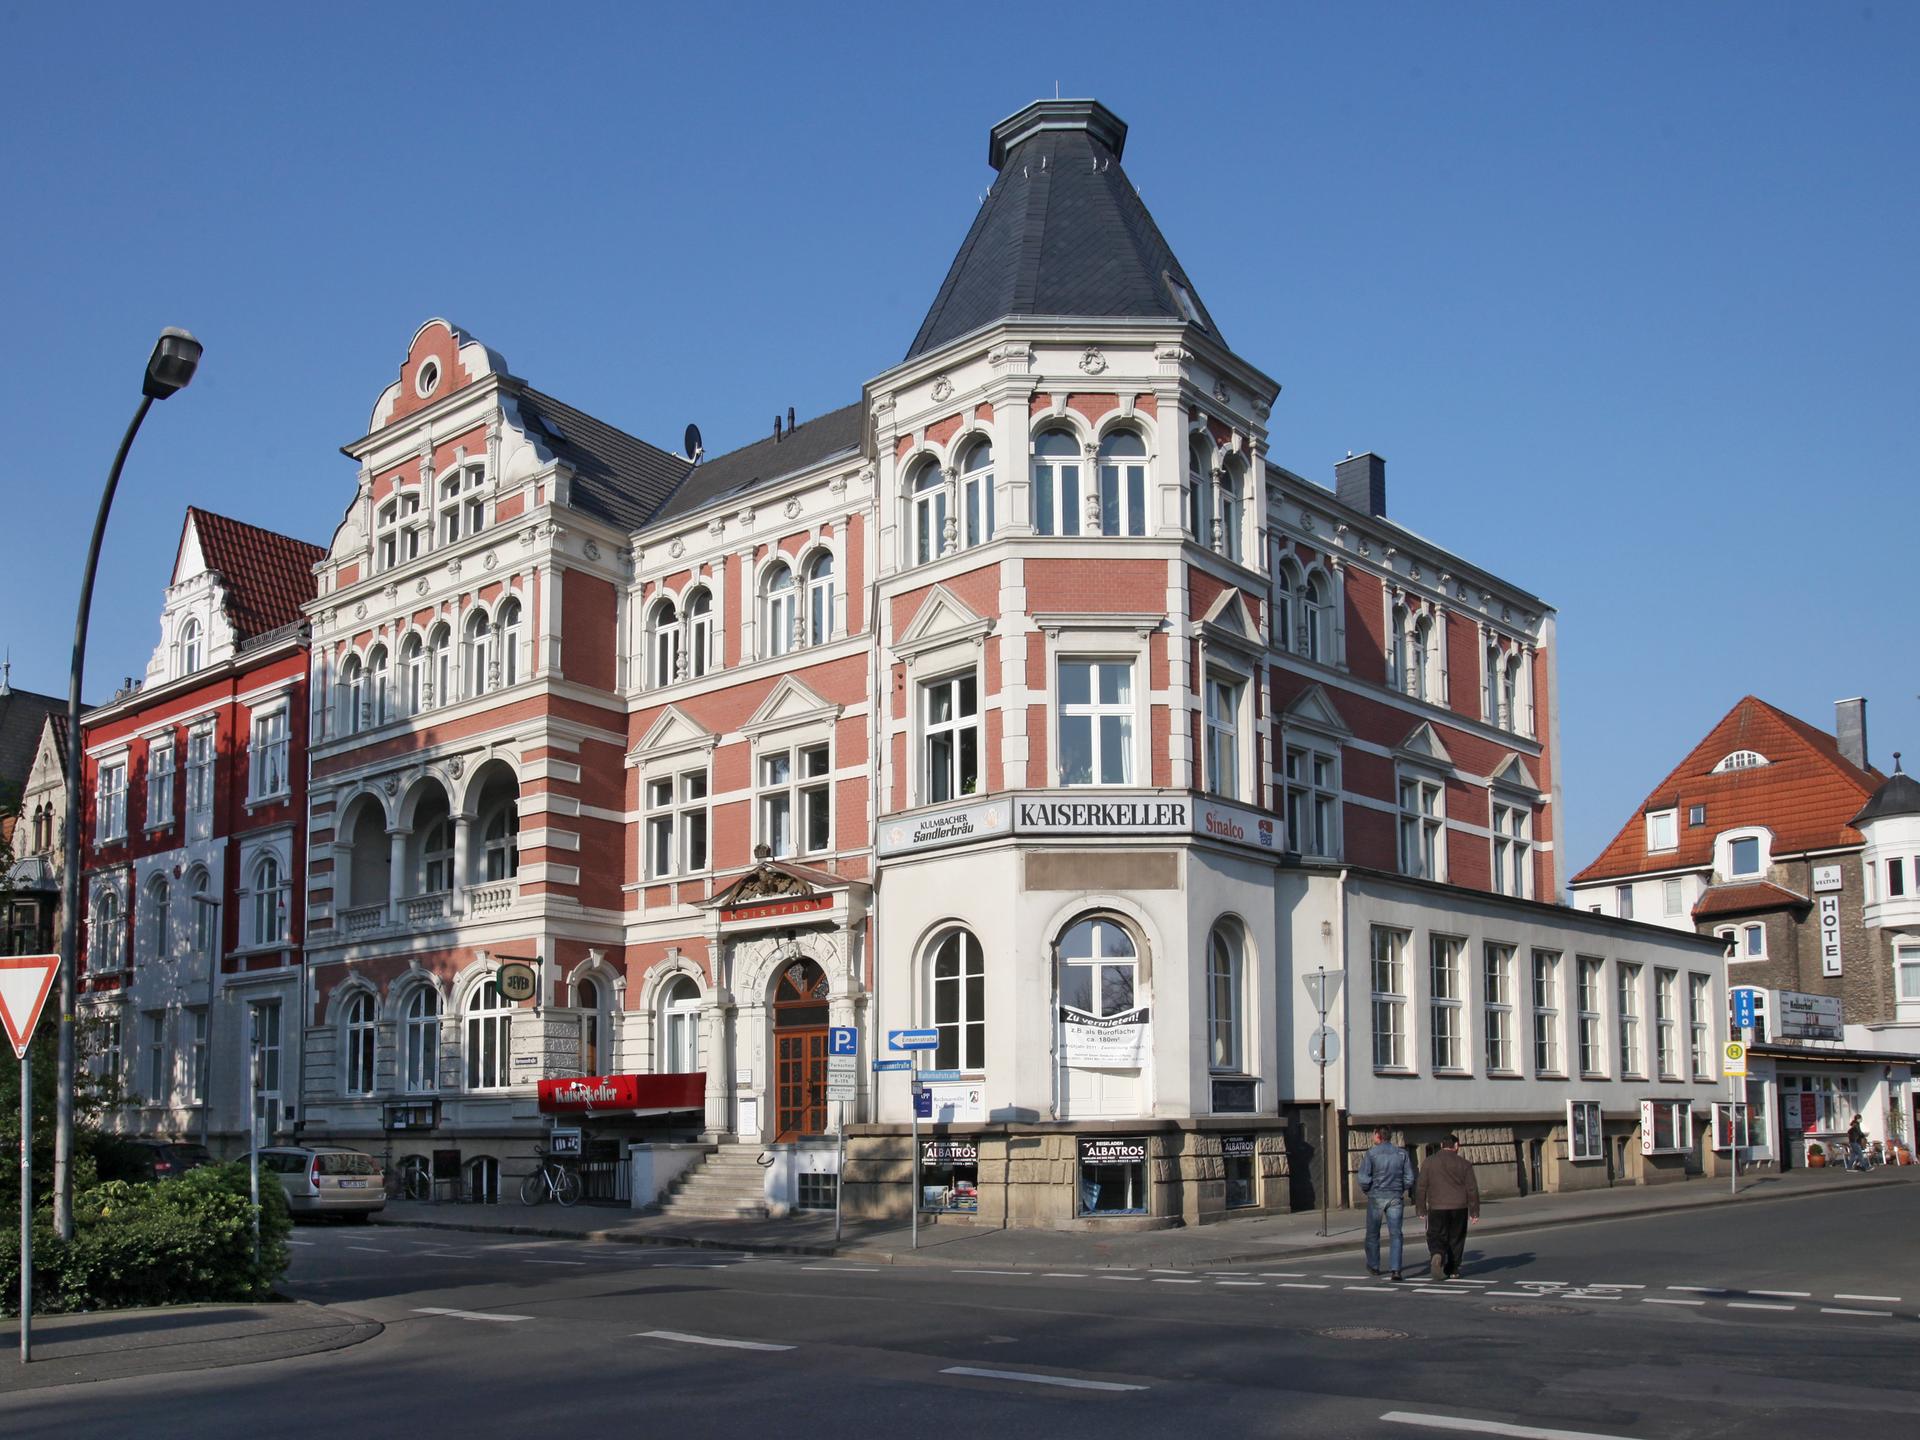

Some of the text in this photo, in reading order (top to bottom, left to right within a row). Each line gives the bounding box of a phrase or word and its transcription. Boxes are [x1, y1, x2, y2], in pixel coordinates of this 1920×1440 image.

[920, 814, 968, 830] KULMBACHER
[1020, 803, 1187, 826] KAISERKELLER
[913, 822, 974, 843] Sandlerbräu
[1206, 812, 1244, 840] Sinalco
[1822, 899, 1840, 972] HOTEL
[507, 975, 529, 991] JEVER
[1740, 991, 1749, 1026] KINO
[1066, 1011, 1140, 1027] Zu vermieten!
[835, 1030, 851, 1052] P
[1730, 1047, 1739, 1057] H
[1642, 1103, 1651, 1150] KINO
[926, 1147, 977, 1158] ALBATROS
[1087, 1146, 1145, 1156] ALBATROS
[1225, 1142, 1254, 1151] ALBATROS
